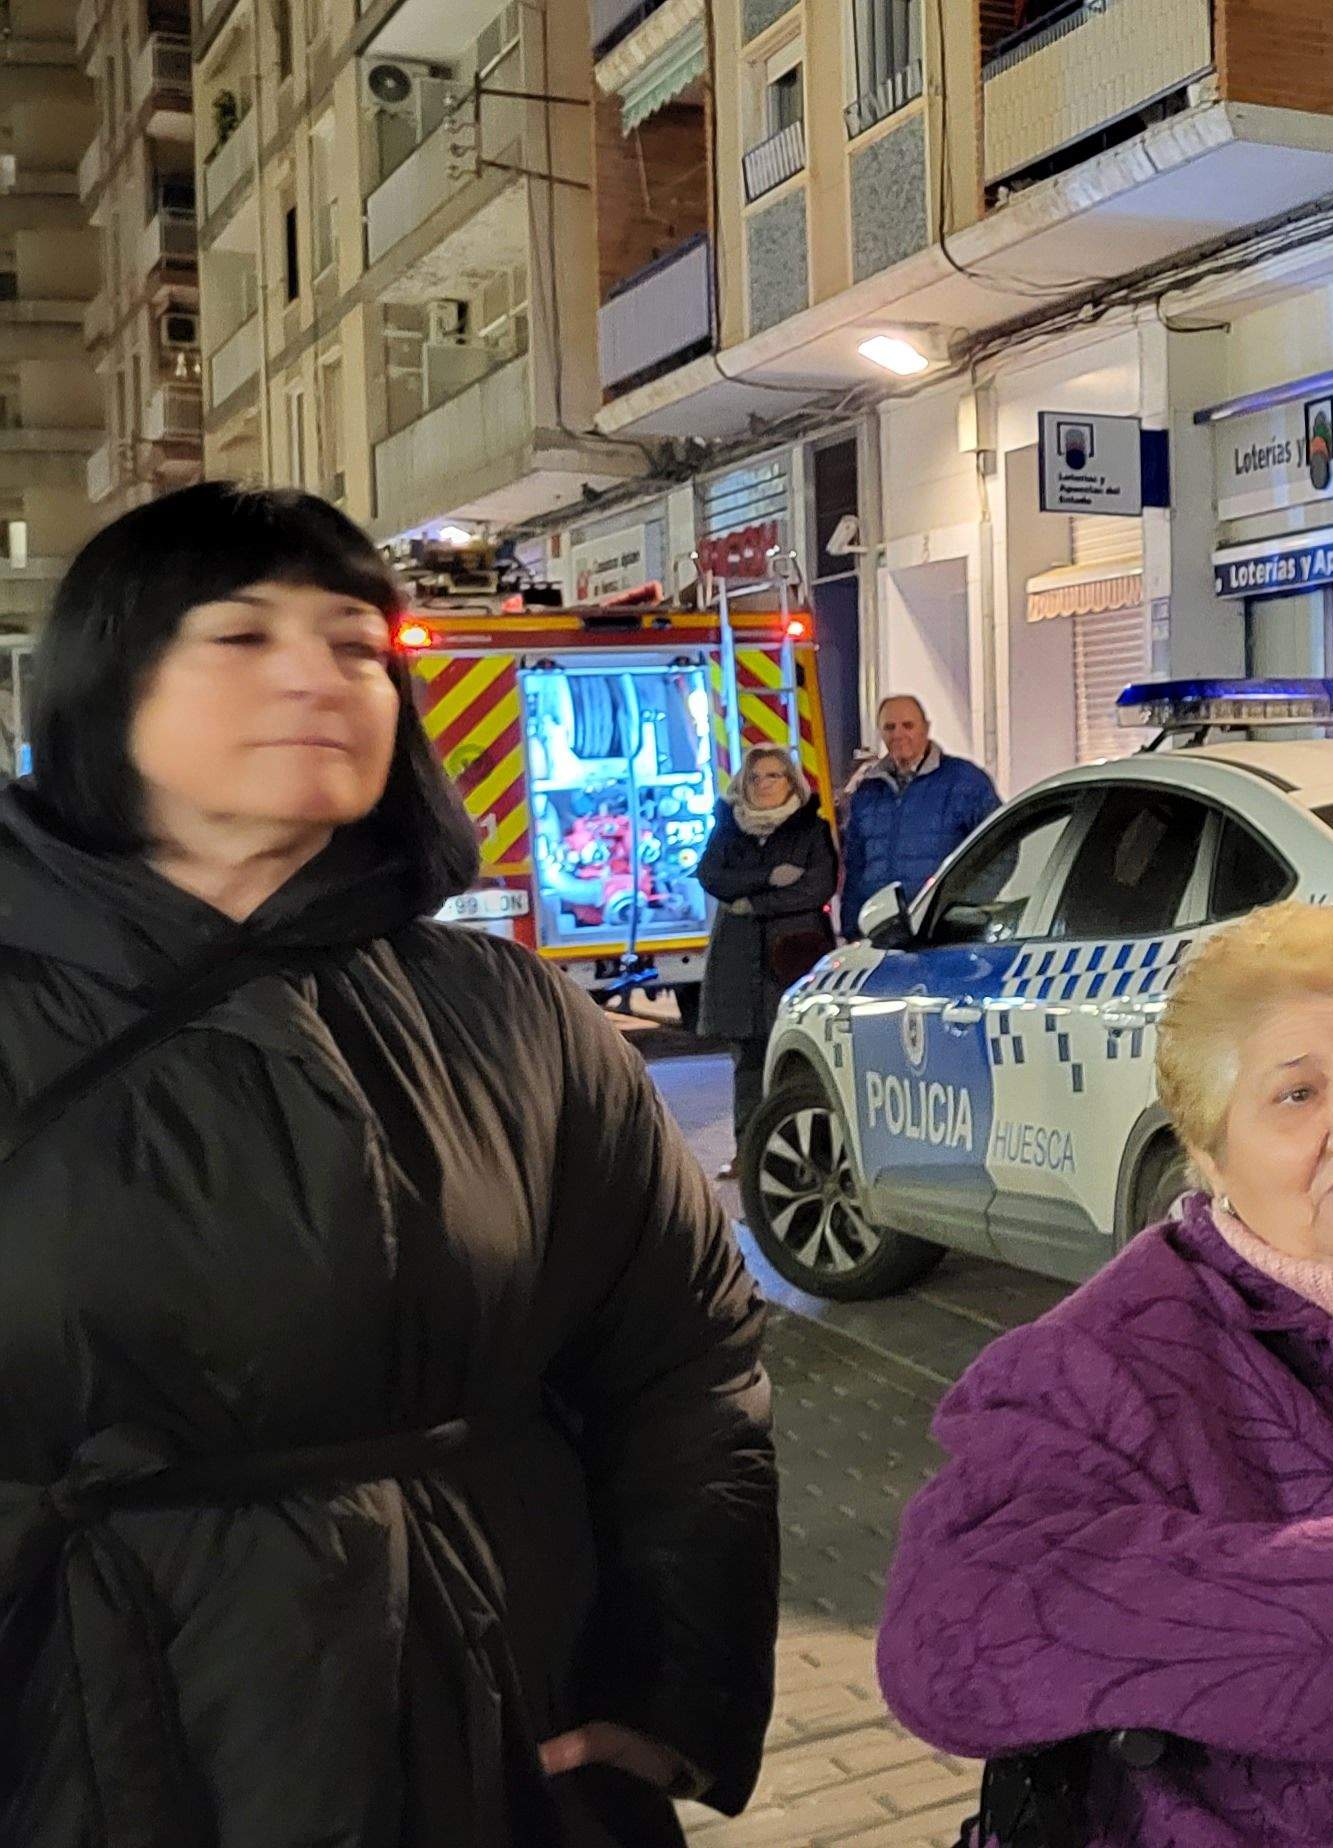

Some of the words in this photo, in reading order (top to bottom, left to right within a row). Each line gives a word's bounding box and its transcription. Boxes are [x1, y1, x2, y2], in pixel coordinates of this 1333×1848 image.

[1234, 435, 1291, 476] Loterías
[1296, 436, 1307, 469] y
[1230, 555, 1296, 588] Loterías
[1300, 554, 1312, 581] y
[866, 1071, 973, 1151] POLICIA
[993, 1120, 1076, 1174] HUESCA
